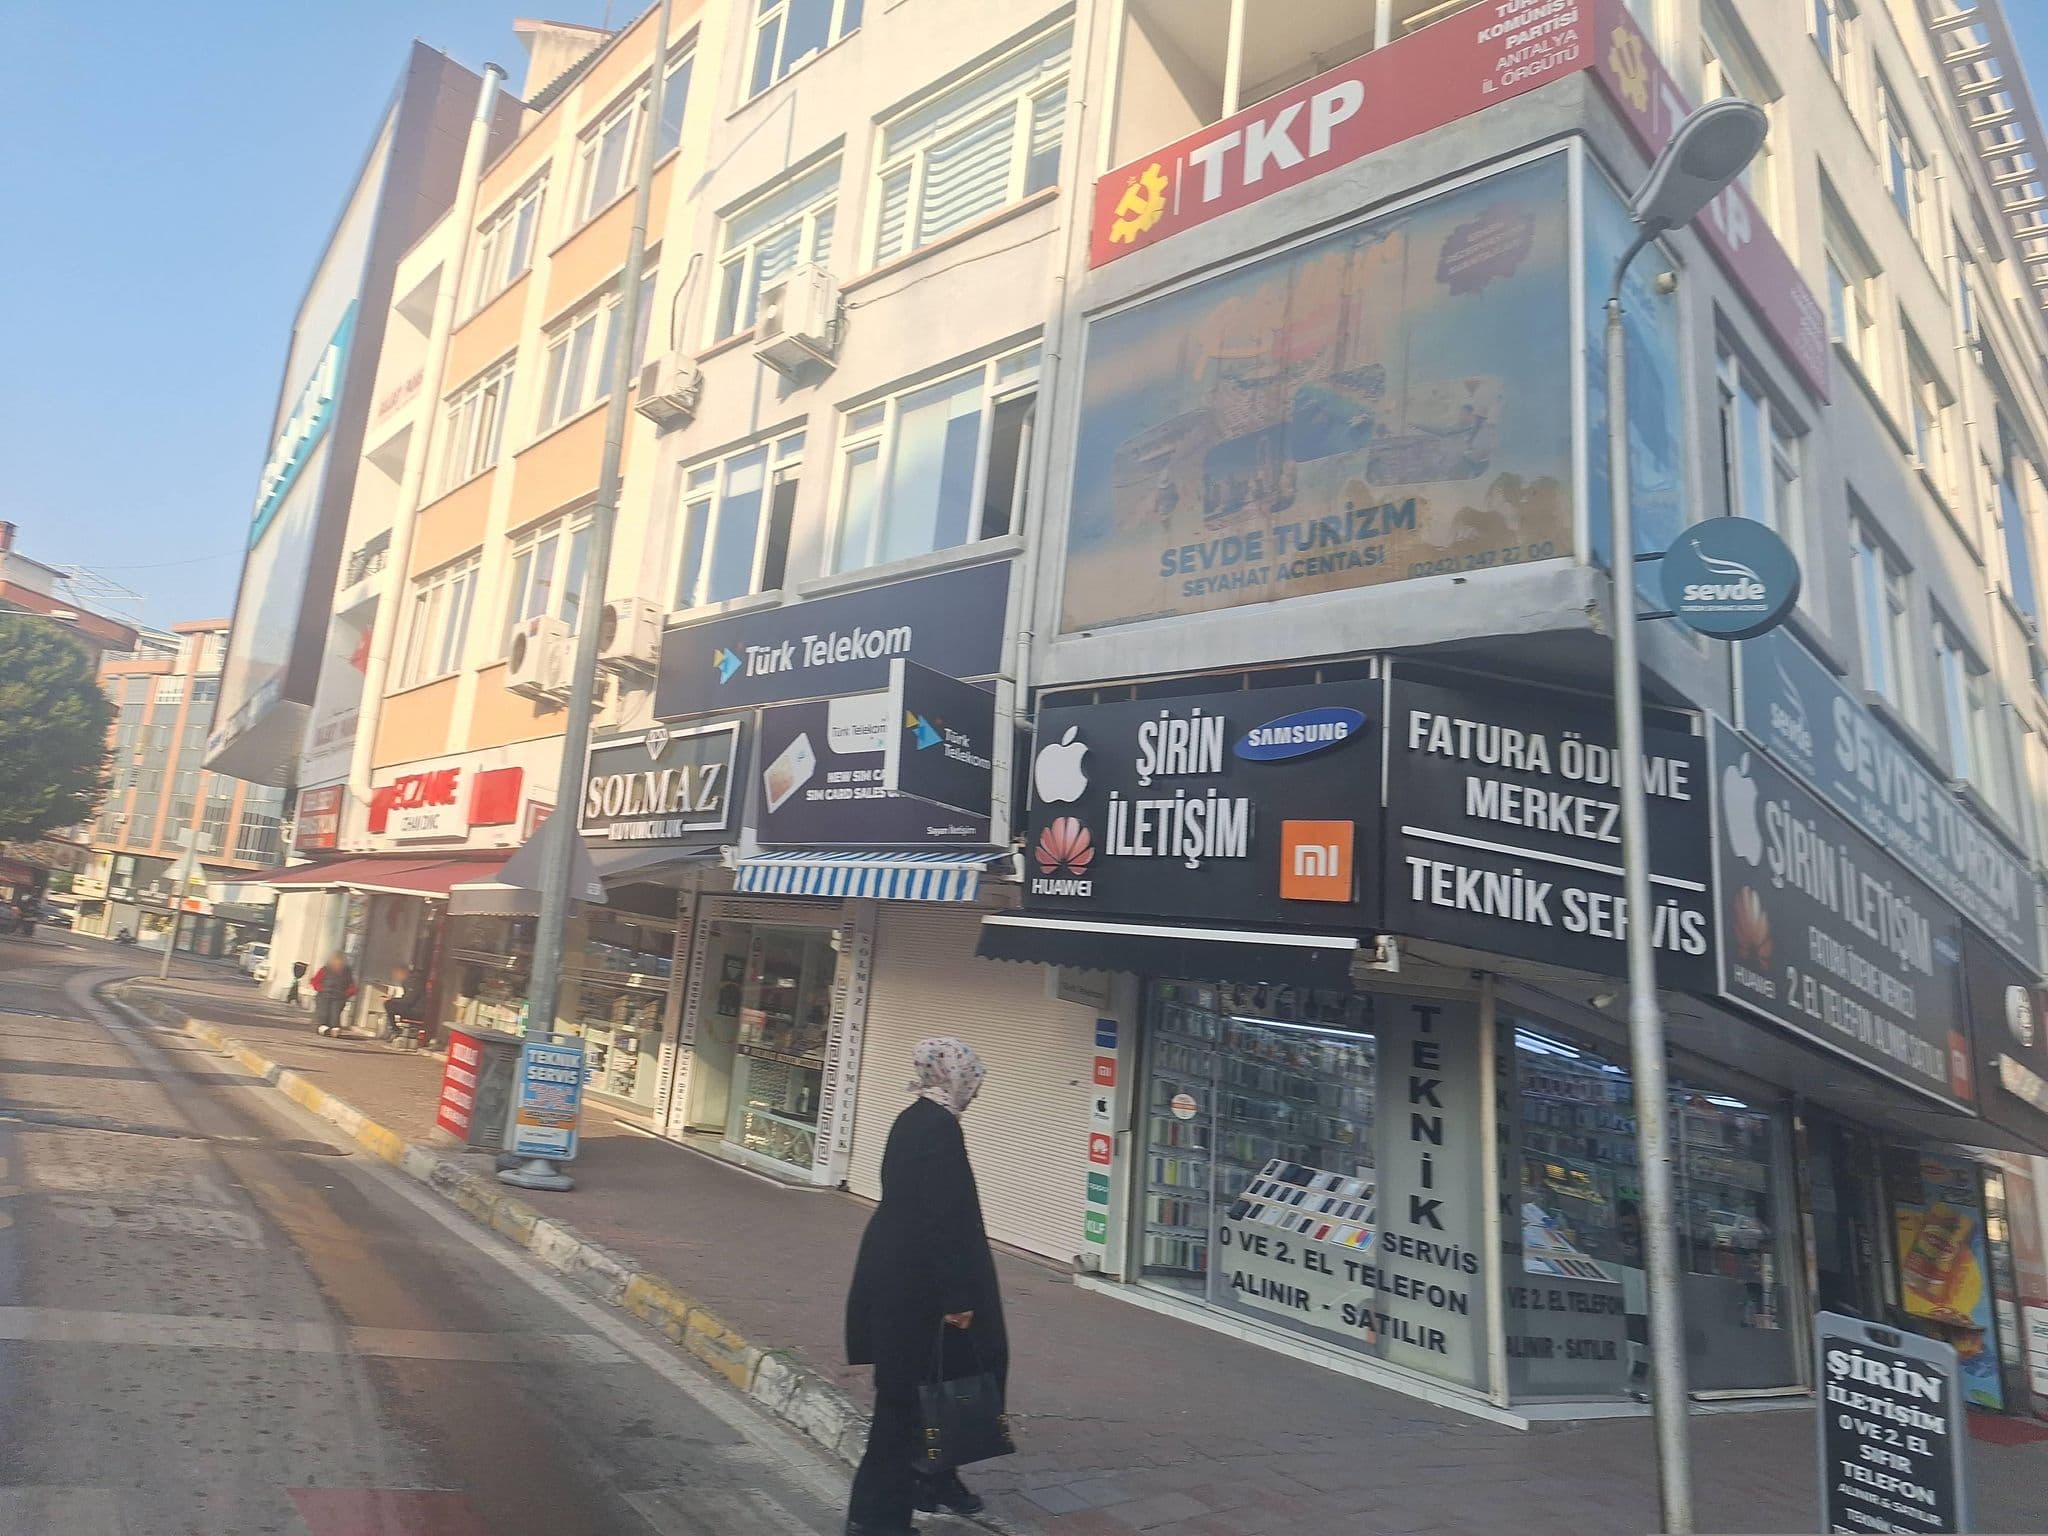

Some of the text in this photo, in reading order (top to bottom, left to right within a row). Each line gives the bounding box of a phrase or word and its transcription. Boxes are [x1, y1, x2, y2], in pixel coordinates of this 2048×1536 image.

[1496, 29, 1579, 71] ANTALYA
[1188, 79, 1365, 203] TKP
[1159, 498, 1416, 578] SEVDE TURİZM
[1182, 565, 1270, 597] SEYAHAT
[1683, 577, 1767, 601] sevde
[745, 625, 913, 677] Türk Telekom
[944, 728, 970, 748] Türk
[944, 744, 992, 770] Telekom
[1136, 707, 1225, 787] ŞİRİN
[1247, 721, 1349, 747] SAMSUNG
[1409, 710, 1552, 775] FATURA
[586, 763, 725, 819] SOLMAZ
[806, 789, 825, 801] SIM
[825, 788, 854, 801] CARD
[853, 786, 887, 800] SALES
[852, 769, 873, 782] SIM
[1833, 696, 1932, 843] SEVDE
[1106, 788, 1249, 870] İLETİŞİM
[1032, 878, 1093, 897] HUAWEI
[1405, 856, 1553, 926] TEKNİK
[1408, 1005, 1444, 1232] TEKNİK
[1240, 1230, 1268, 1257] VE
[1275, 1241, 1296, 1265] 2.
[1303, 1248, 1334, 1276] EL
[1344, 1259, 1469, 1316] TELEFON
[1381, 1231, 1479, 1276] SERVİS
[1232, 1270, 1312, 1313] ALINIR
[1341, 1303, 1447, 1355] SATILIR
[1827, 1349, 1943, 1403] ŞİRİN
[1827, 1380, 1946, 1435] İLETİŞİM
[1853, 1418, 1883, 1441] VE
[1906, 1435, 1934, 1457] EL
[1840, 1461, 1936, 1506] TELEFON
